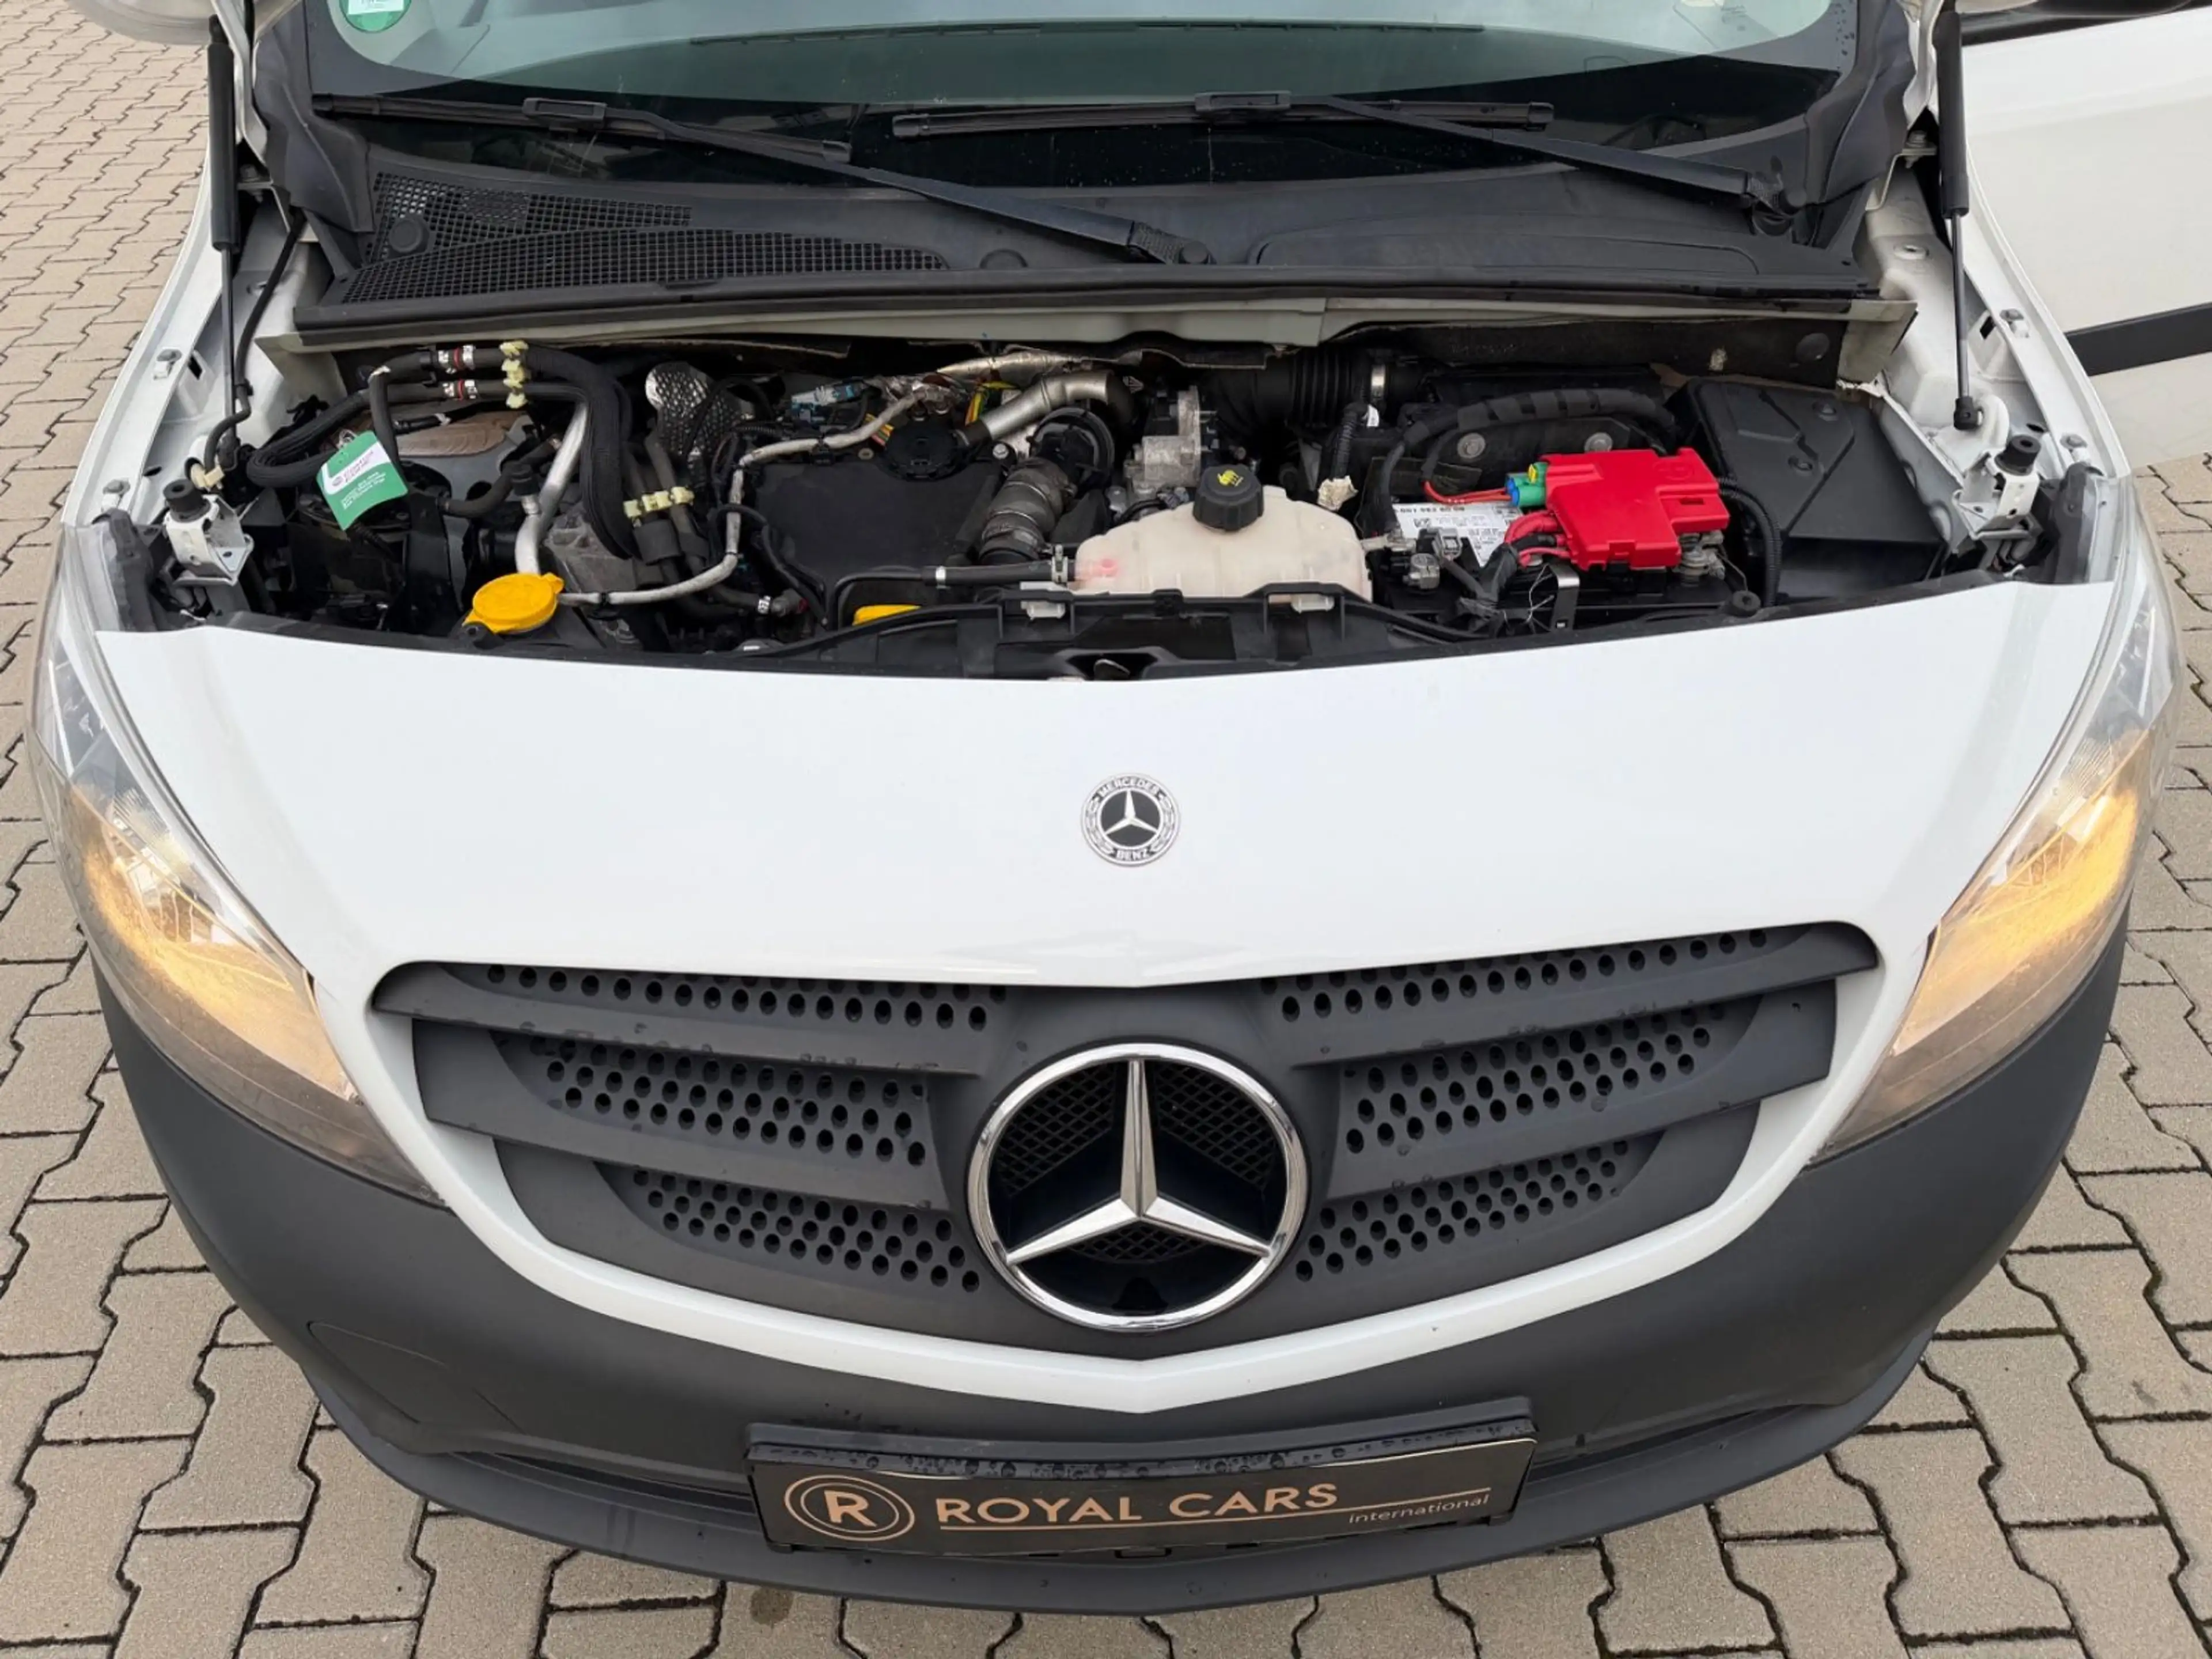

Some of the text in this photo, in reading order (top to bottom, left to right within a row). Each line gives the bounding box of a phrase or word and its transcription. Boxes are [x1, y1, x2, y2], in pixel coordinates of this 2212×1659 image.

[1097, 777, 1160, 797] MERCEDES
[1116, 848, 1150, 861] BENZ
[824, 1490, 878, 1527] R
[935, 1483, 1338, 1524] ROYAL CARS
[1349, 1494, 1490, 1524] international
